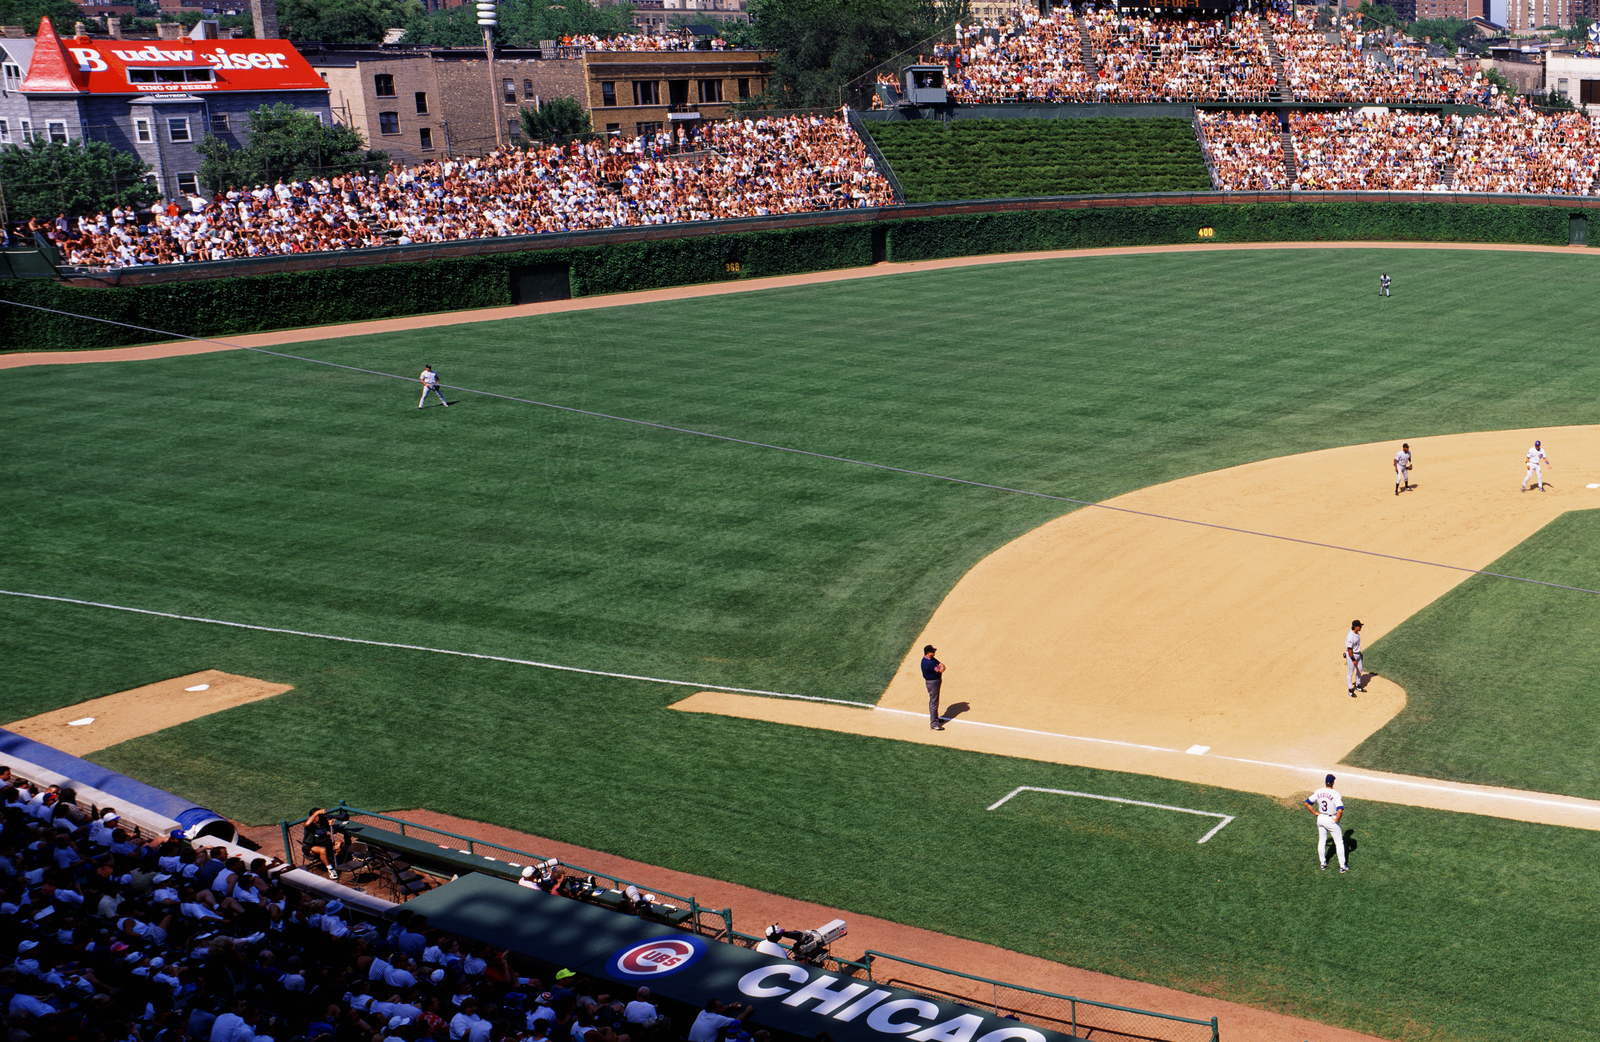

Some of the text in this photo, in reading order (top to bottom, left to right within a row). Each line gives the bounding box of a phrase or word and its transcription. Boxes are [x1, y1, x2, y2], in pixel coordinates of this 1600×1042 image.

[1198, 227, 1213, 237] 400
[725, 262, 740, 272] 368
[1321, 800, 1328, 812] 3
[622, 941, 690, 972] CUBS
